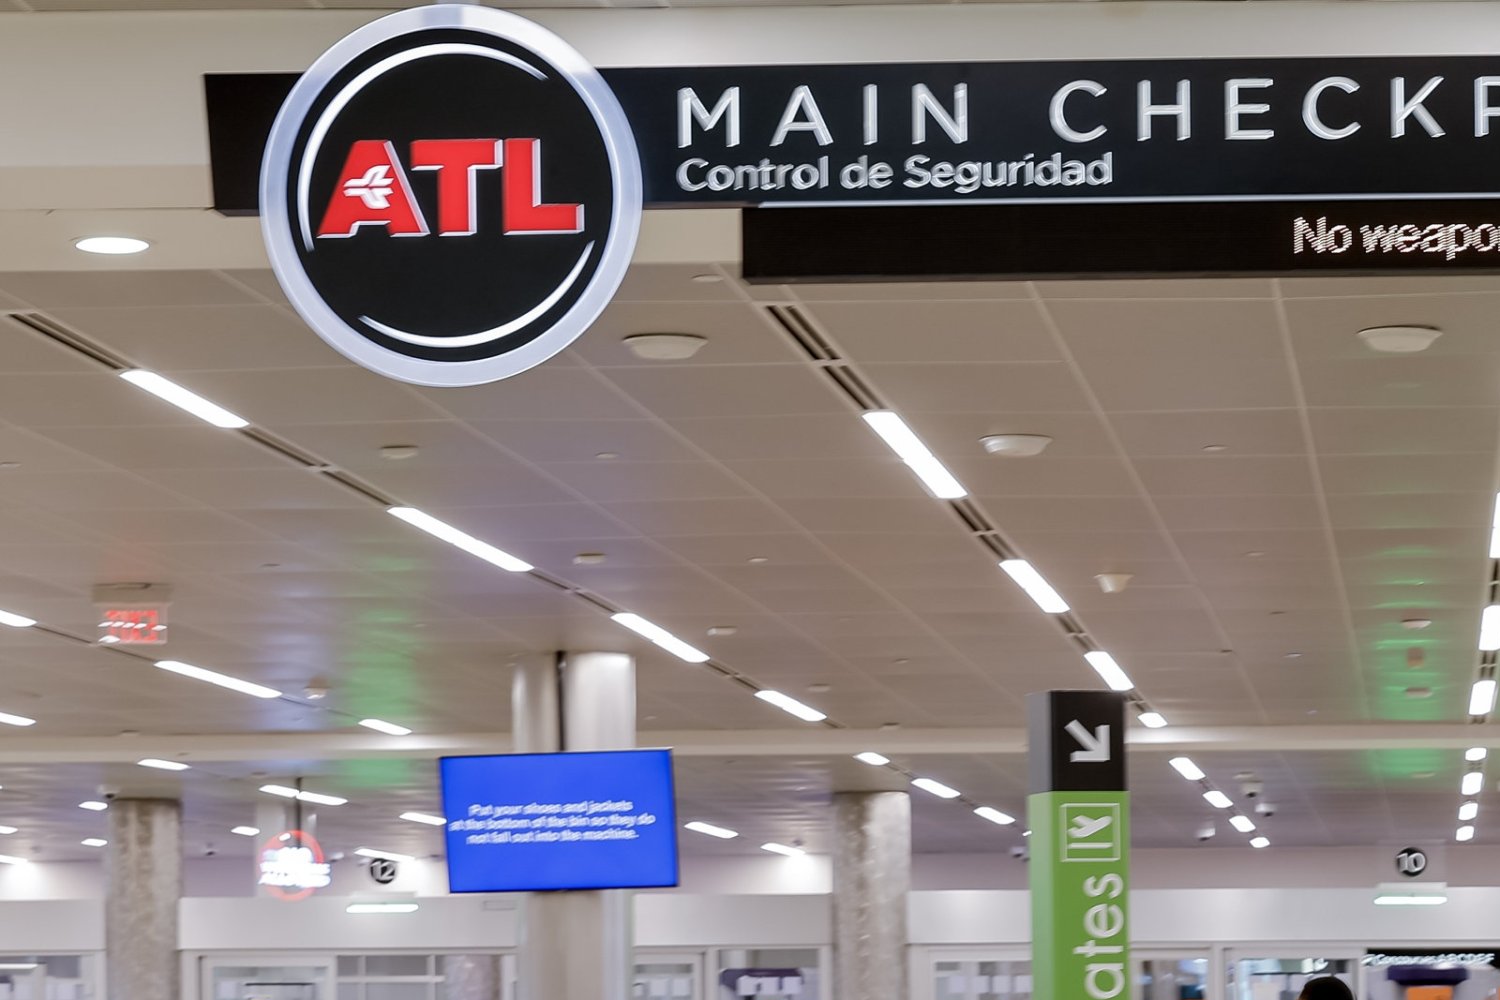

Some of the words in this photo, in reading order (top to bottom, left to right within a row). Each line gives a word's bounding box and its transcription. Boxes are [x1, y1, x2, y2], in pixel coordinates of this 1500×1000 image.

[677, 82, 968, 148] MAIN
[676, 156, 829, 192] Control
[840, 154, 894, 190] de
[903, 152, 1113, 194] Seguridad
[316, 138, 585, 238] ATL
[1294, 216, 1353, 254] No
[468, 804, 493, 817] Put
[493, 805, 523, 818] your
[522, 802, 562, 815] shoes
[562, 801, 587, 814] and
[586, 800, 633, 815] jackets
[448, 819, 464, 832] at
[464, 818, 484, 830] the
[485, 817, 530, 829] bottom
[531, 816, 546, 829] of
[546, 815, 567, 828] the
[568, 814, 590, 827] bin
[590, 816, 608, 827] so
[607, 813, 637, 828] they
[636, 812, 656, 825] do
[466, 832, 489, 845] not
[489, 831, 511, 843] fall
[511, 831, 534, 843] out
[534, 830, 560, 842] into
[560, 829, 582, 841] the
[370, 860, 396, 881] 12
[1396, 852, 1426, 873] 10
